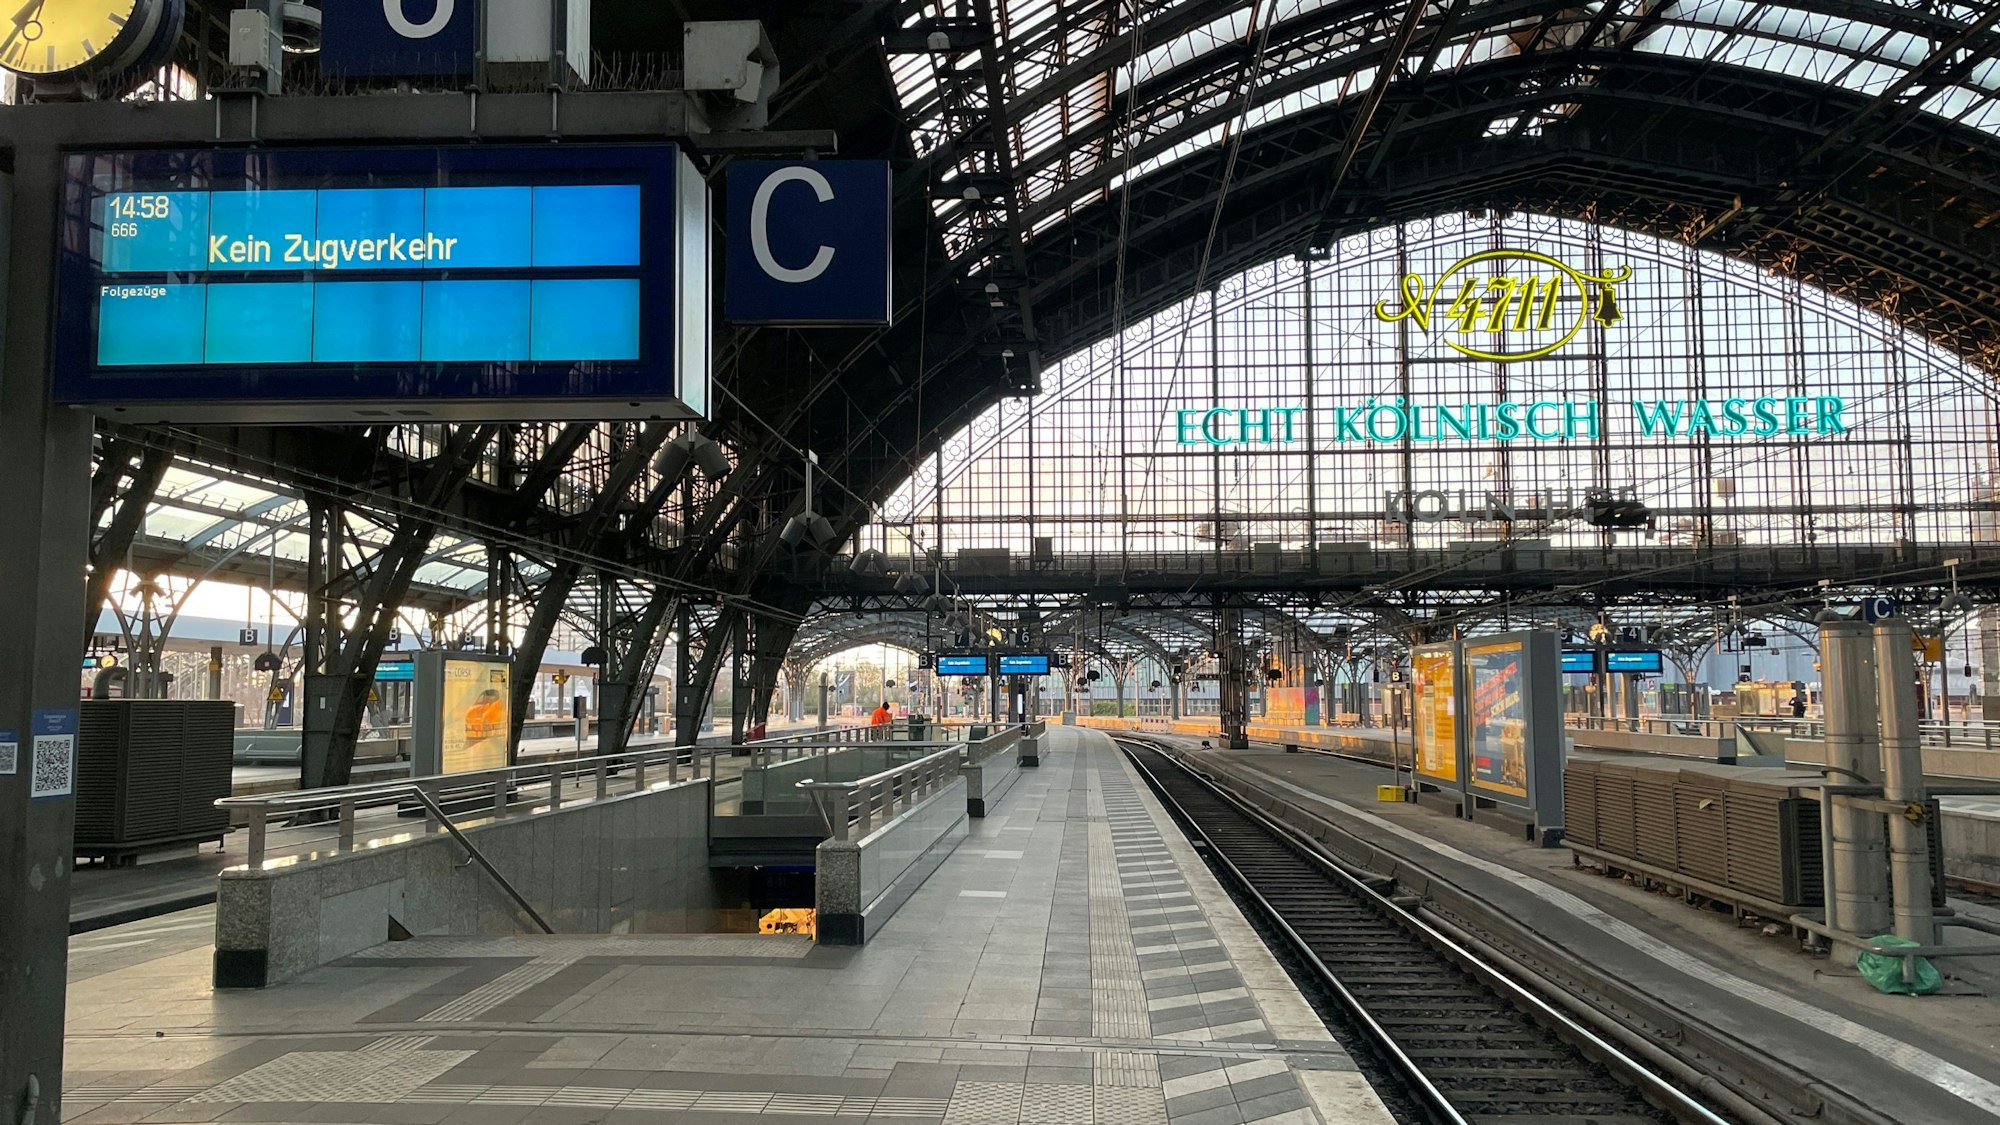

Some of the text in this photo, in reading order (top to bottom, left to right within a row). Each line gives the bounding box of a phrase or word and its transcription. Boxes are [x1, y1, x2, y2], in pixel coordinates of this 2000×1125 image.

[109, 195, 170, 219] 14:58
[111, 222, 139, 238] 666
[750, 165, 836, 284] C
[208, 231, 459, 270] Kein Zugverkehr
[100, 285, 168, 299] Folgezüge
[1444, 274, 1563, 334] 4711
[1175, 395, 1849, 446] ECHT KÖLNISCH WASSER
[1873, 598, 1890, 618] C
[244, 629, 255, 643] B
[387, 627, 399, 642] B
[463, 631, 473, 644] 8
[1021, 631, 1029, 643] 6
[1628, 627, 1637, 639] 4
[919, 655, 928, 667] B
[1058, 654, 1067, 665] B
[1391, 672, 1400, 681] B
